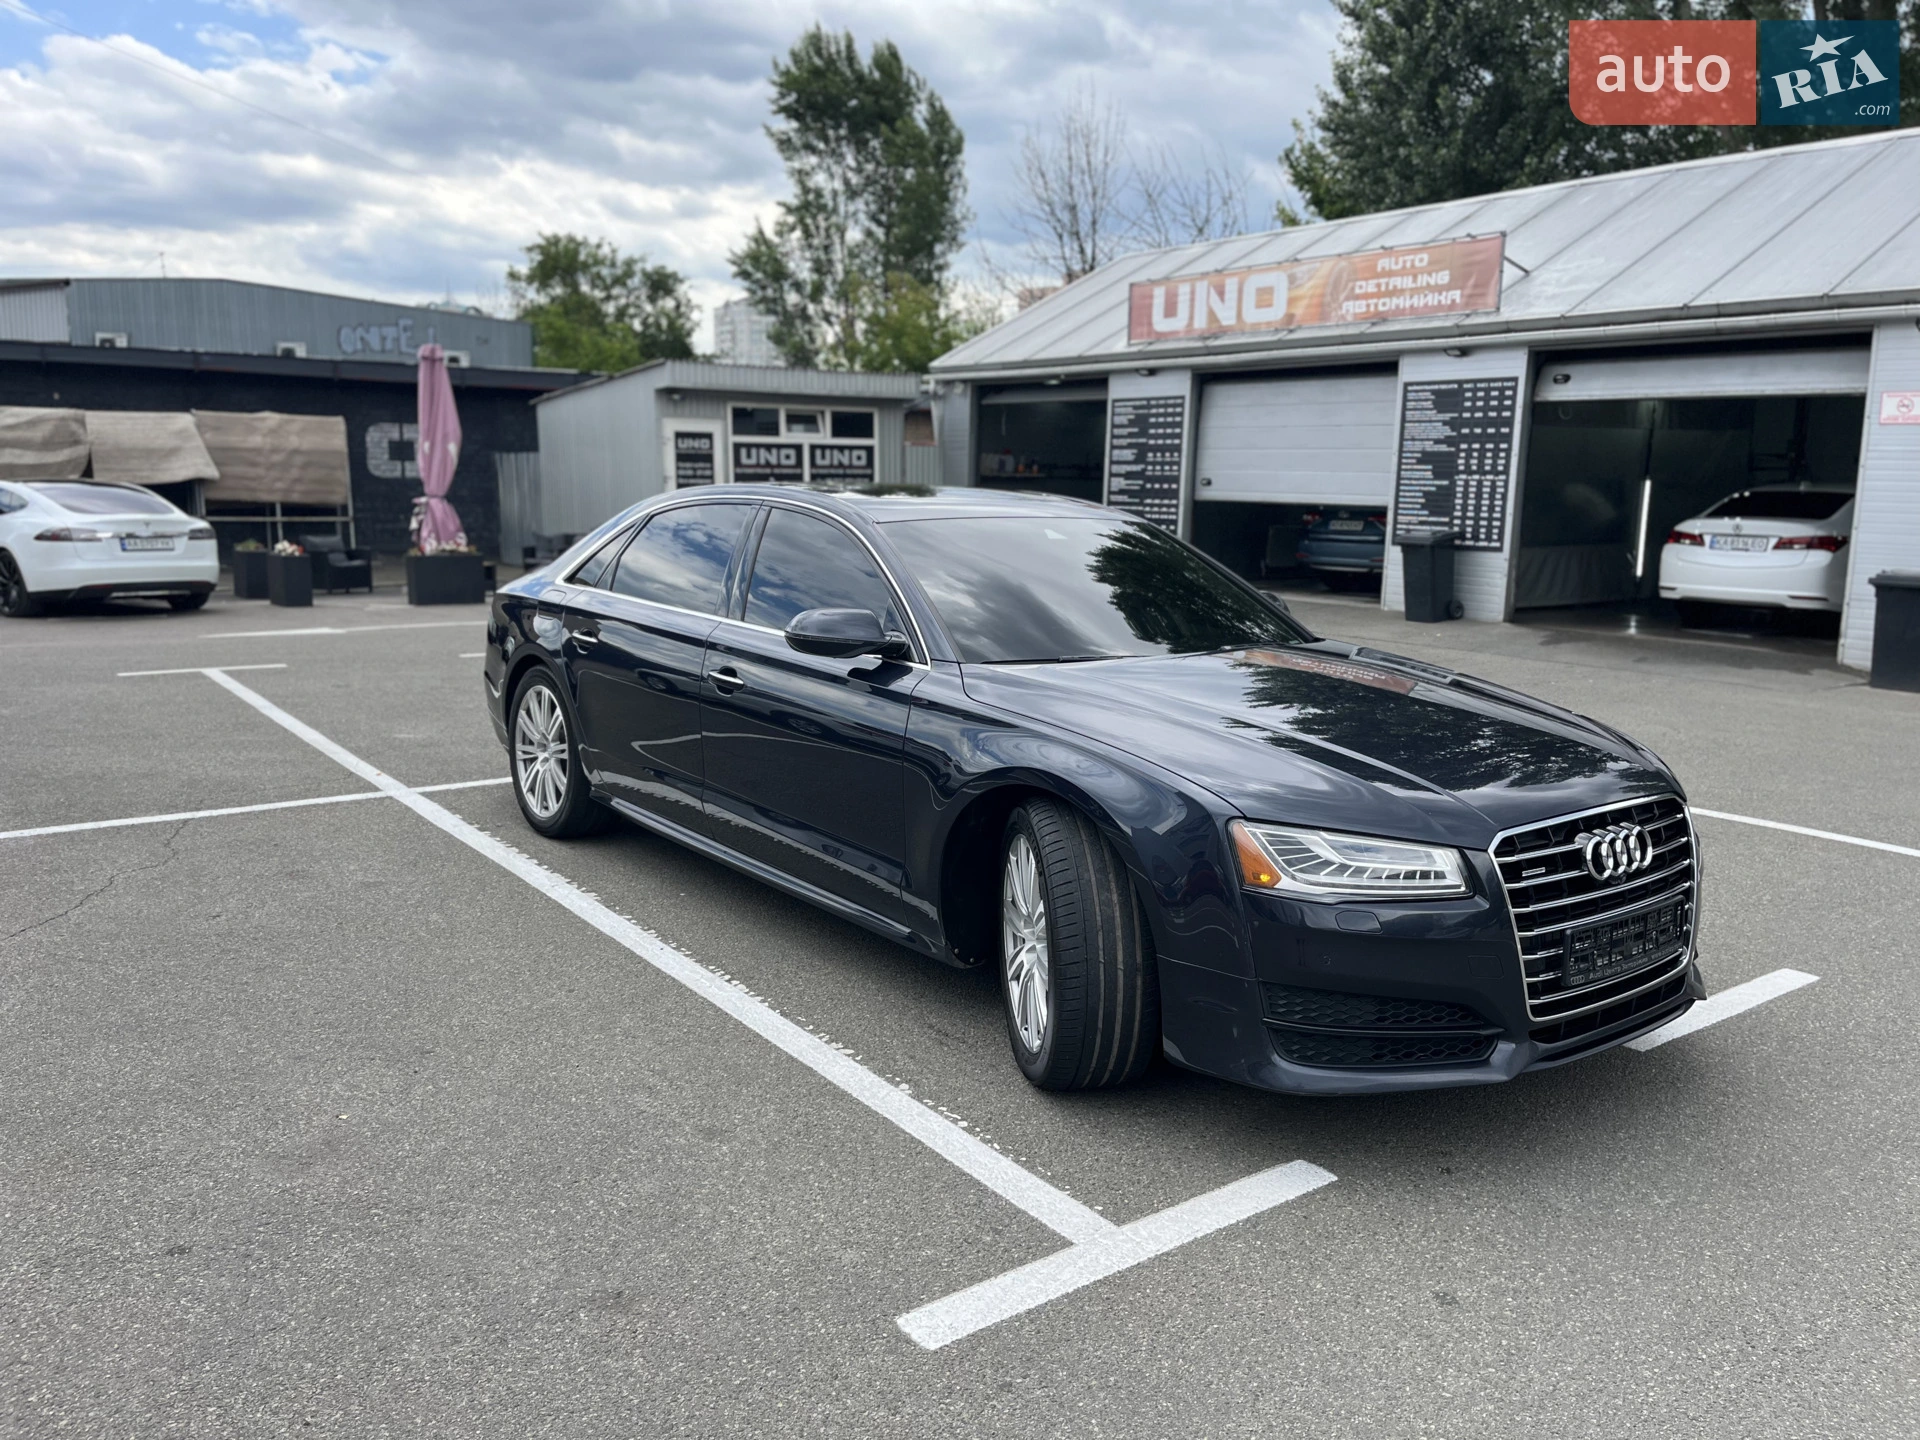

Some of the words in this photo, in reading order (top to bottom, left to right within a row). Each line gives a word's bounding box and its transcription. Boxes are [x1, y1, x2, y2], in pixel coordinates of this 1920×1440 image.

[1377, 252, 1430, 272] AUTO
[1354, 270, 1451, 294] DETAILING
[1151, 270, 1289, 333] UNO
[1341, 289, 1462, 314] АВТОМИЙКА
[677, 437, 711, 449] UNO
[739, 446, 797, 466] UNO
[814, 448, 868, 467] UNO
[1589, 969, 1603, 980] Audi
